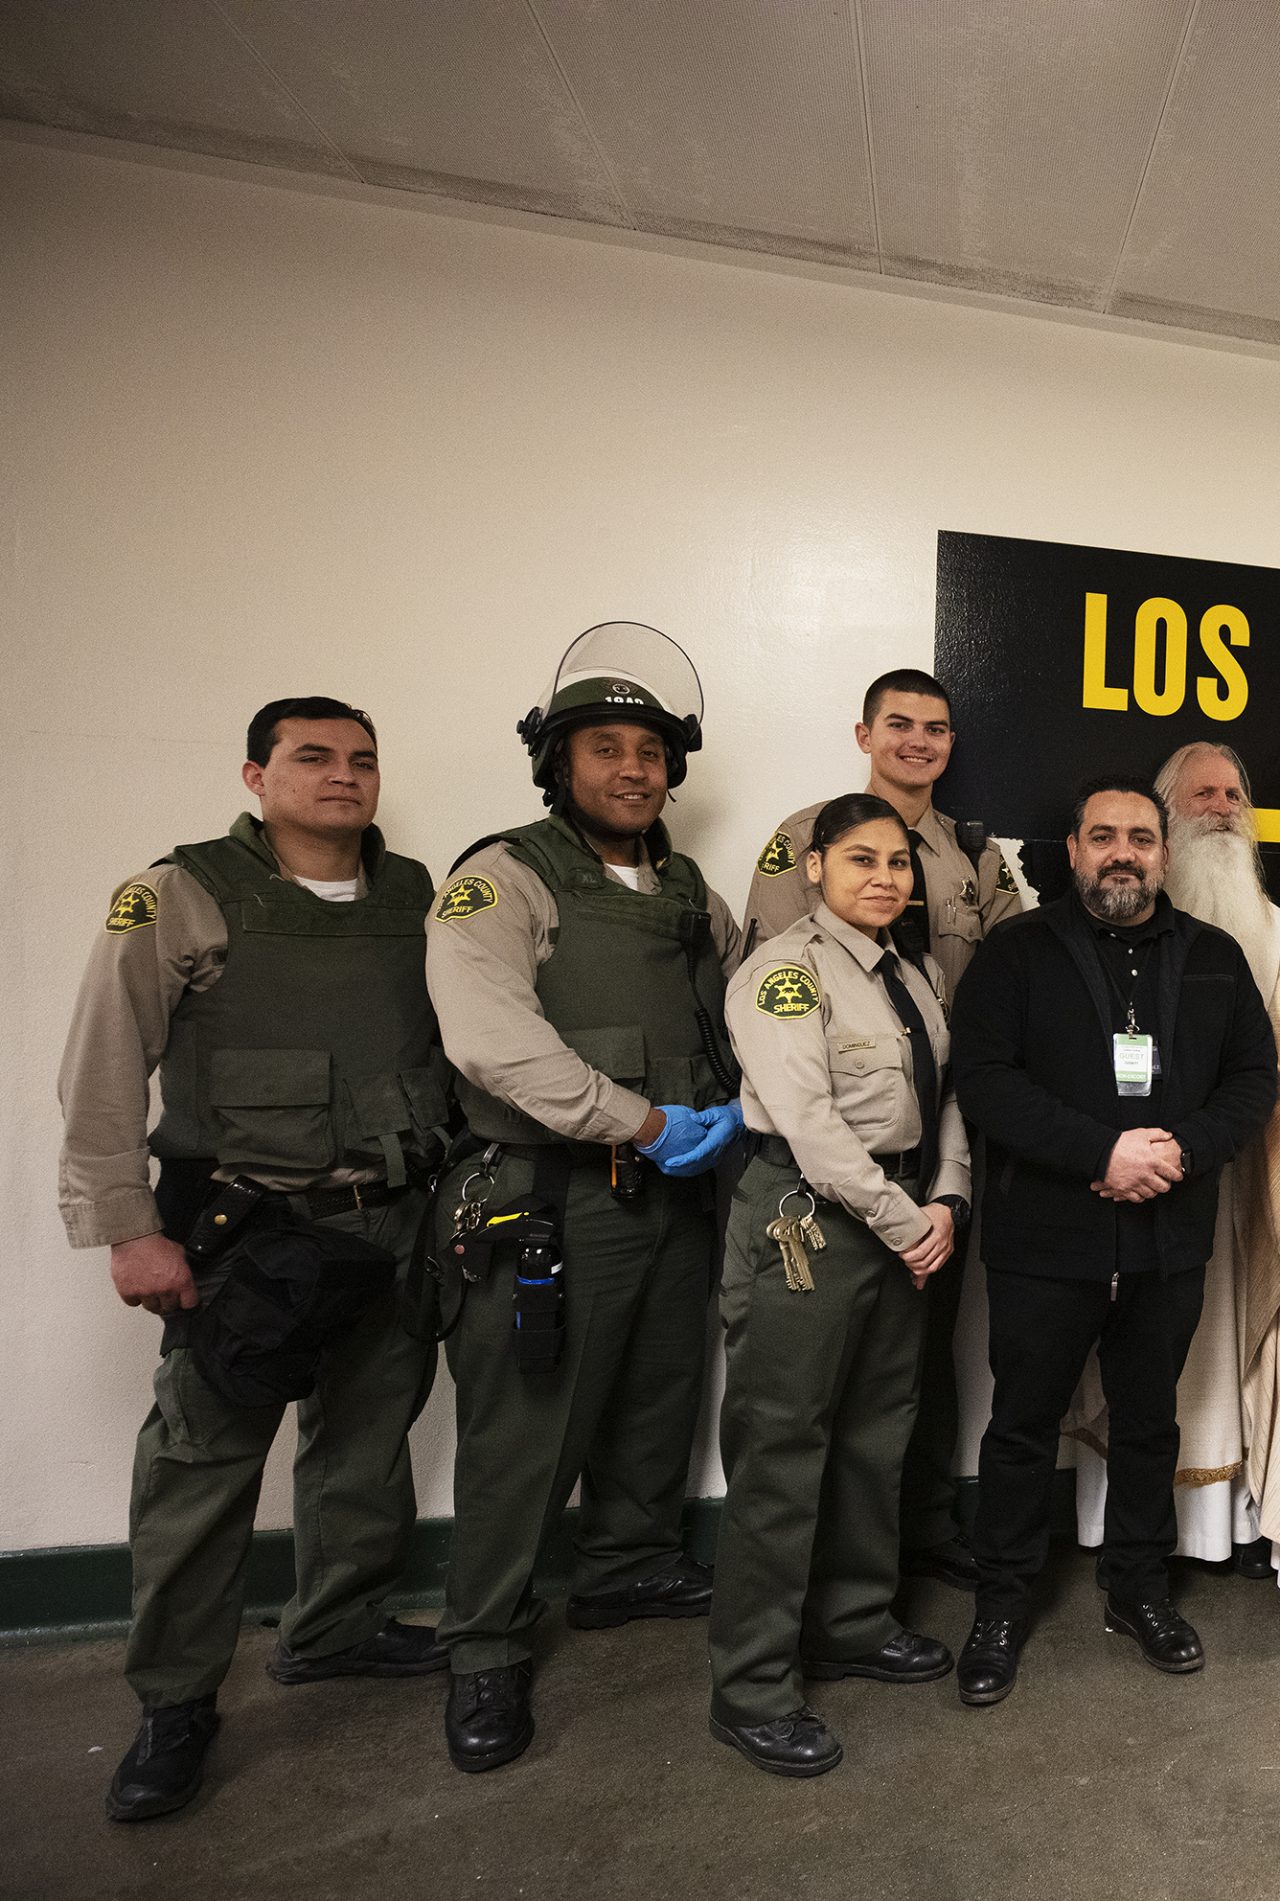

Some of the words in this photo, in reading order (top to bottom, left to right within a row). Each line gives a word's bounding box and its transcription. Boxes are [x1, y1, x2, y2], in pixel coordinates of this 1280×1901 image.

[1082, 591, 1250, 721] LOS
[758, 990, 768, 1006] LOS
[764, 970, 800, 990] ANGELES
[799, 974, 819, 1003] COUNTY
[773, 1002, 810, 1014] SHERIFF
